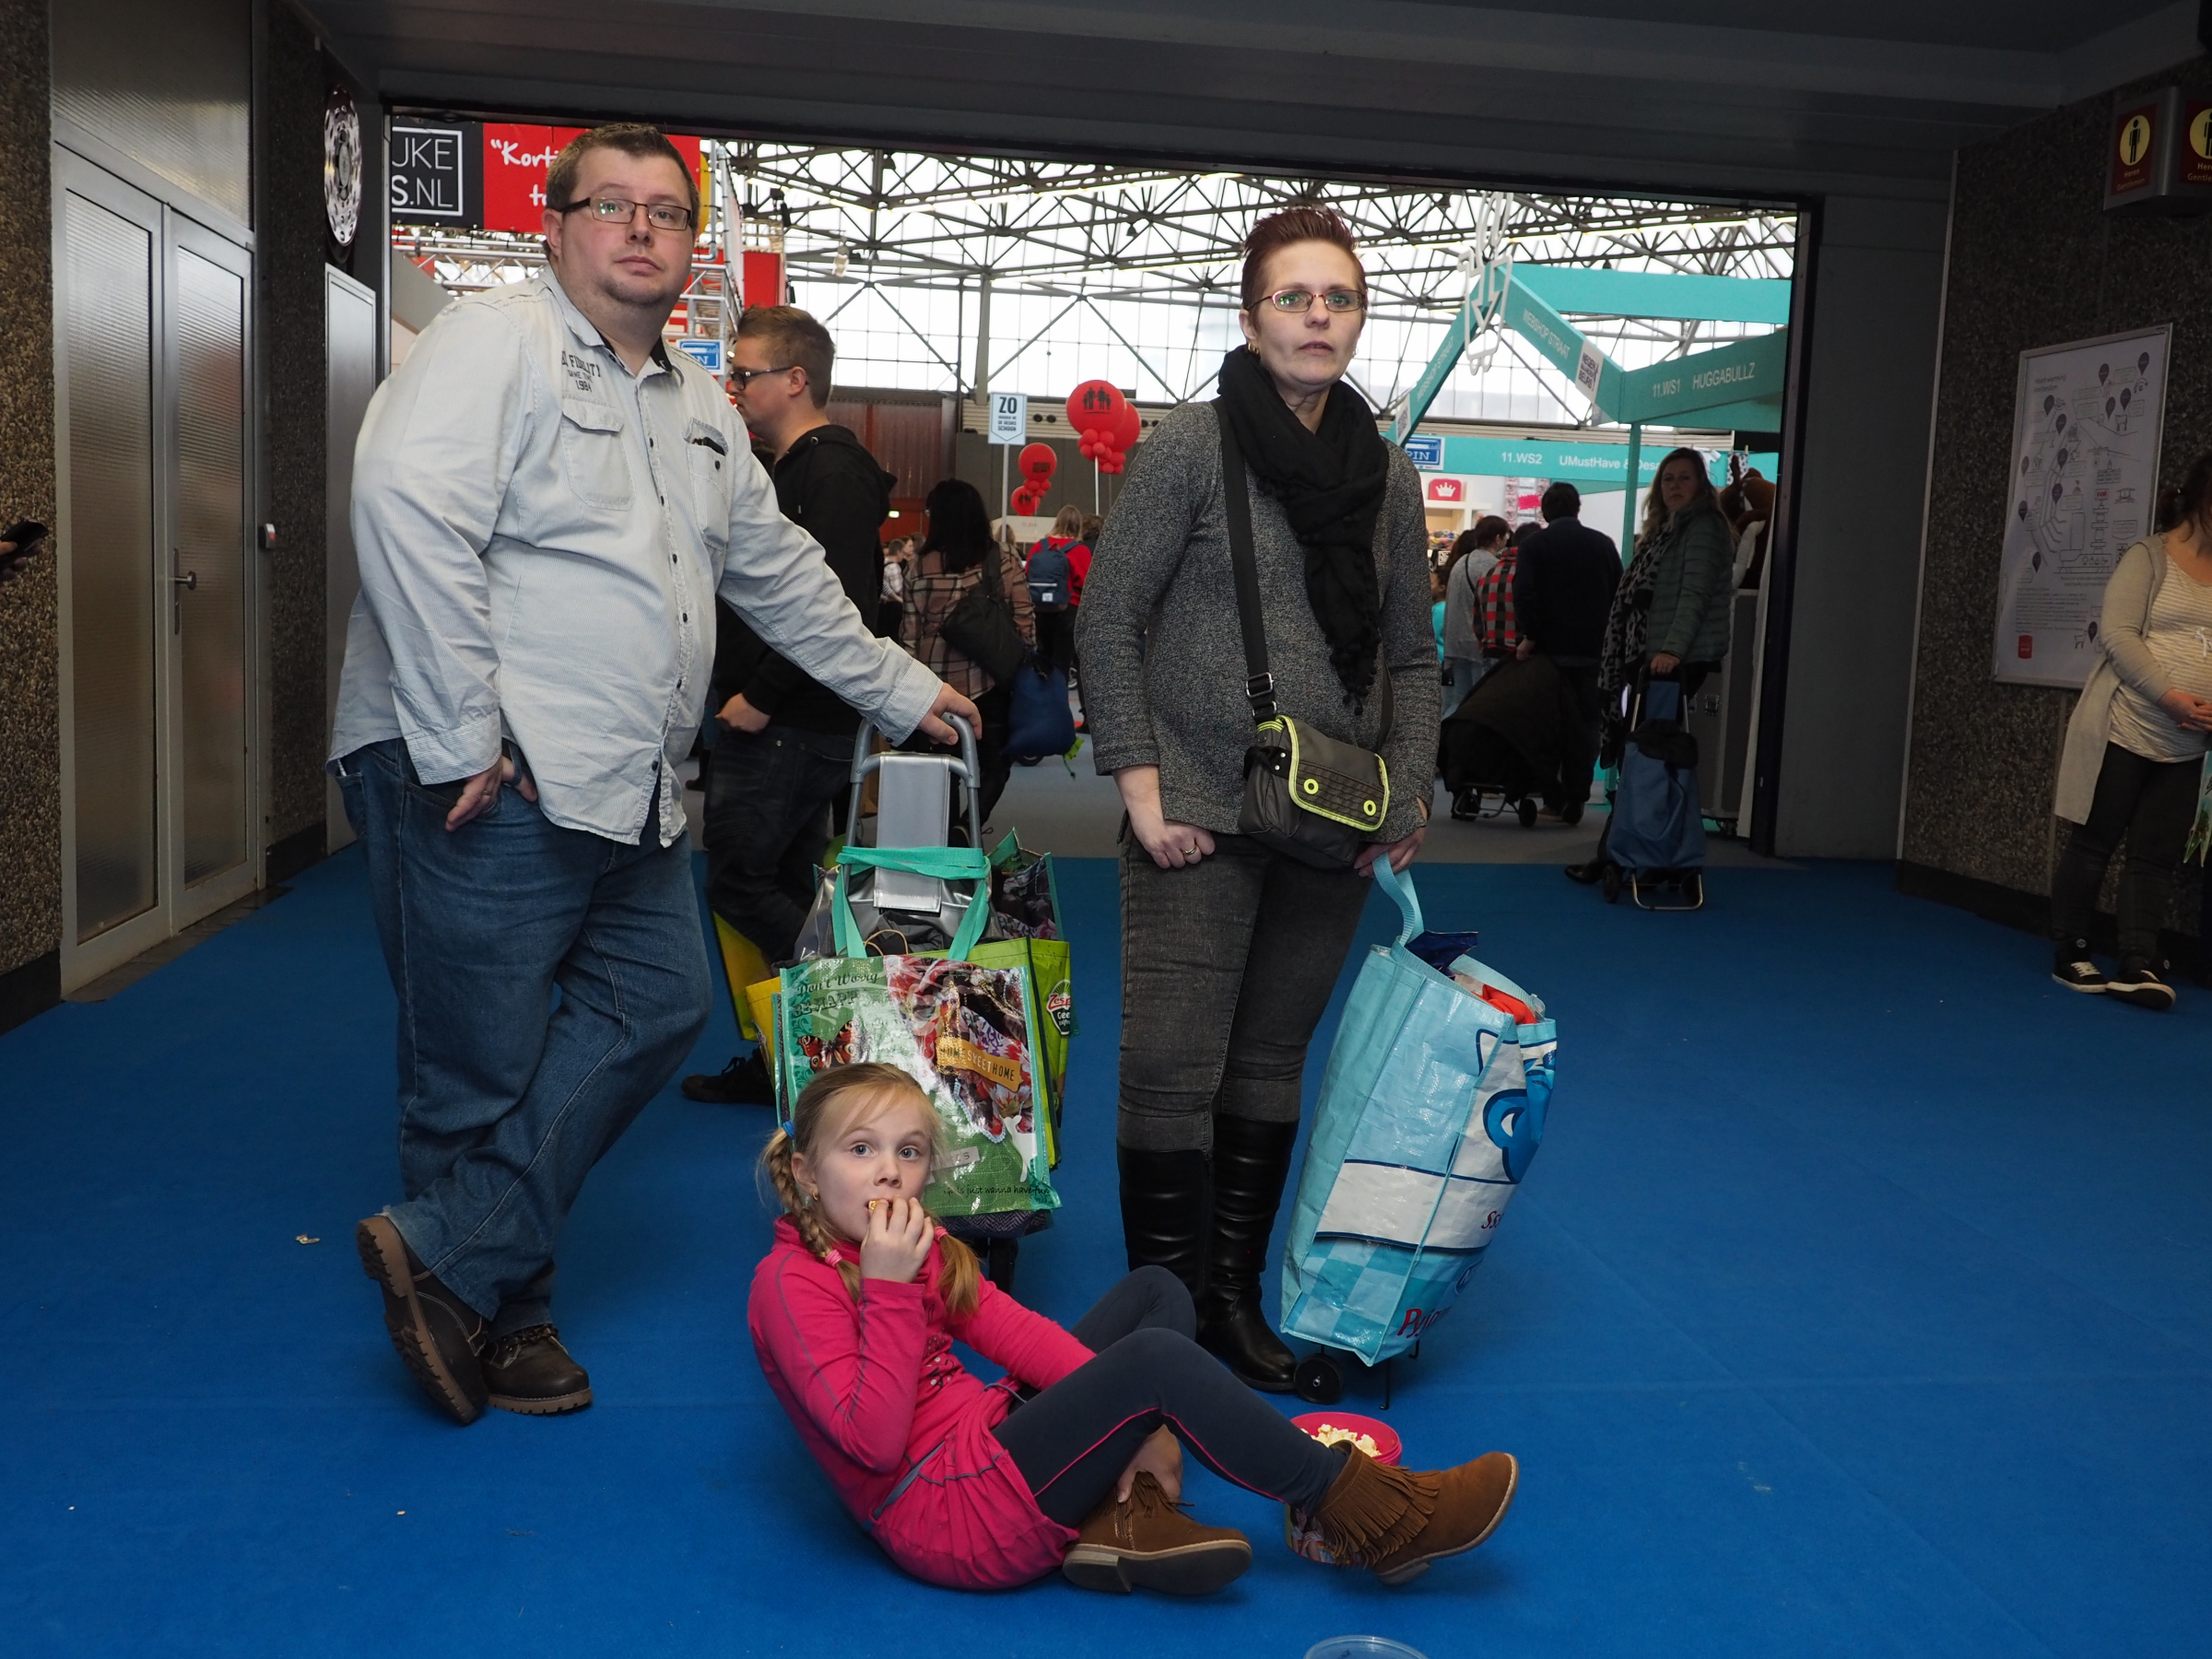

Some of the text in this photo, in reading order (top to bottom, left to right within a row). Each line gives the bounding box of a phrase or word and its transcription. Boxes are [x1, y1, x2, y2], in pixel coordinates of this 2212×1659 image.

[2124, 168, 2140, 178] Heren
[1653, 362, 1756, 398] 11.WS1 HUGGABULLZ
[999, 396, 1018, 414] ZO
[1501, 452, 1543, 465] 11.WS2
[1559, 455, 1620, 469] UMustHave
[796, 972, 878, 997] Don't Worry
[967, 1050, 992, 1073] SWEET
[992, 1063, 1015, 1082] HOME
[967, 1184, 983, 1195] just
[984, 1184, 1012, 1195] wanna
[1014, 1183, 1032, 1194] have
